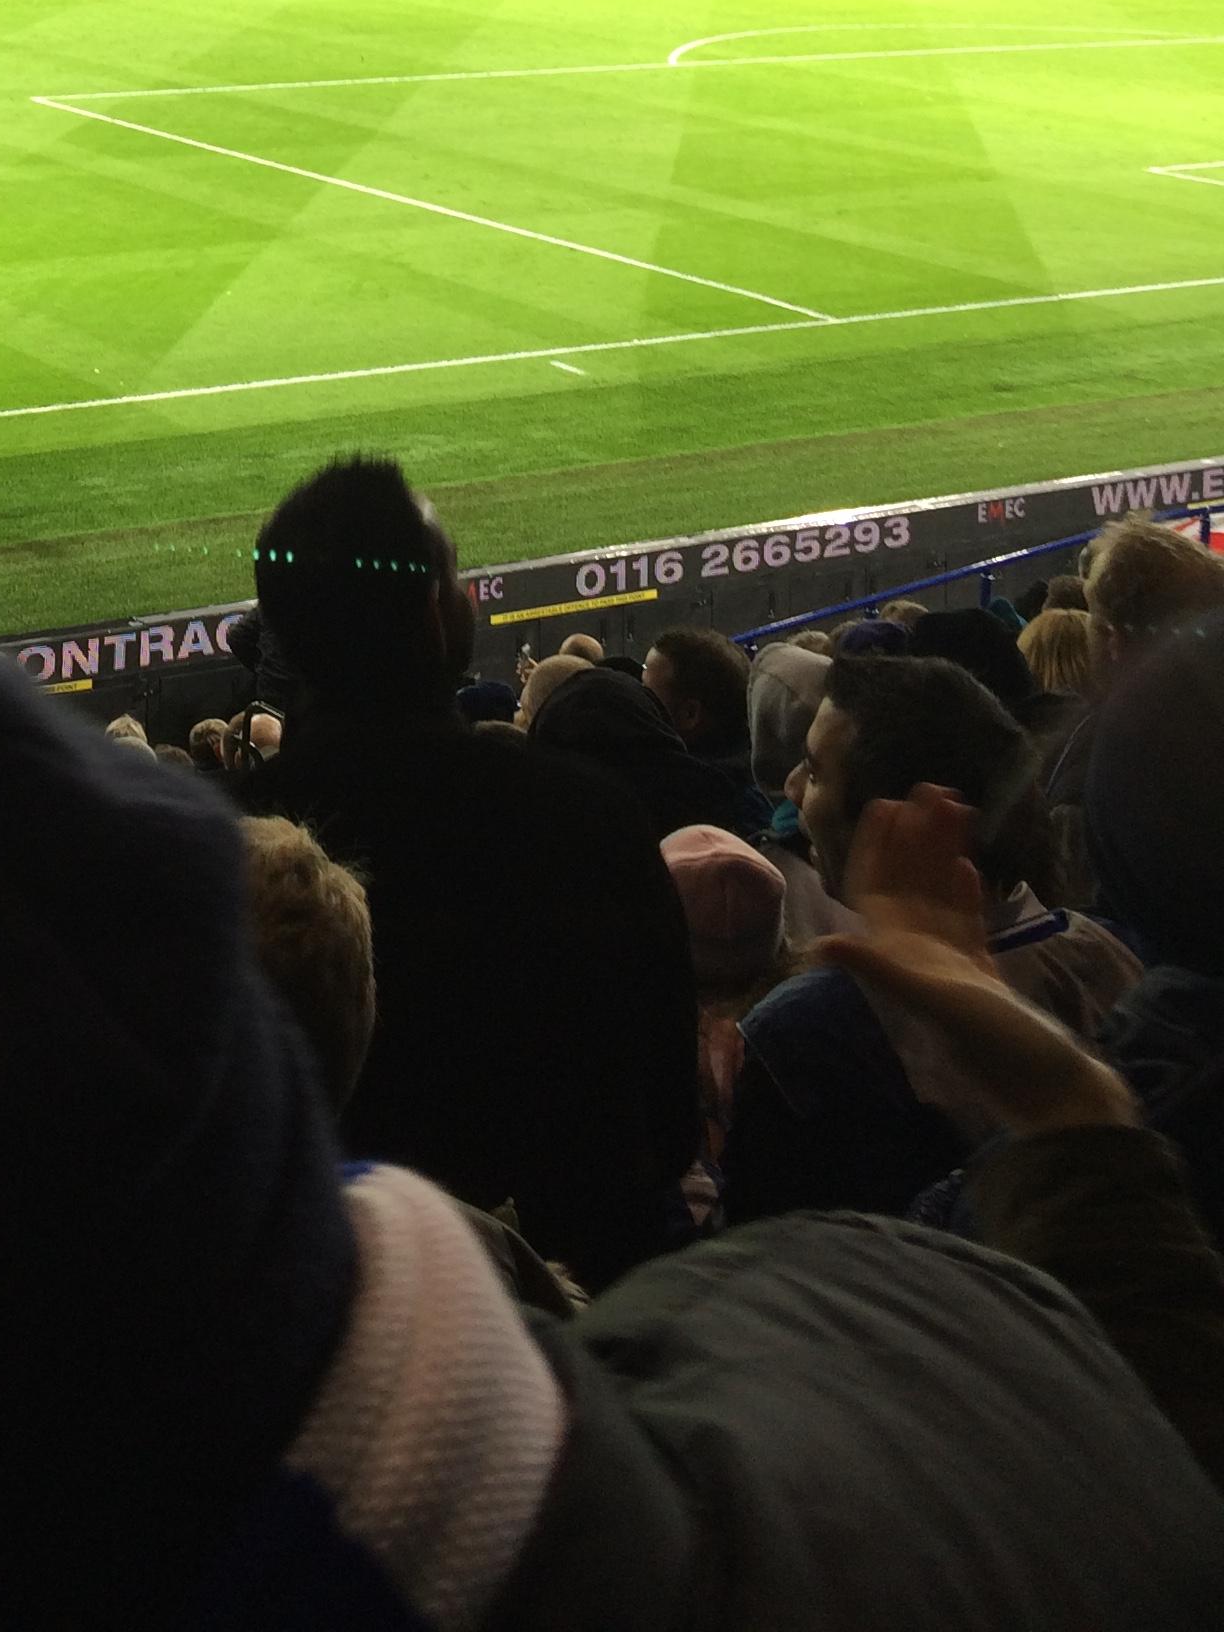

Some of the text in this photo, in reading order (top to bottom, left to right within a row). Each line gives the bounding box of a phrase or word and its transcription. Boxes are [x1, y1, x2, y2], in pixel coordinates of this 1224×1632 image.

[978, 497, 1026, 526] EMEC
[576, 516, 911, 597] 0116 2665293
